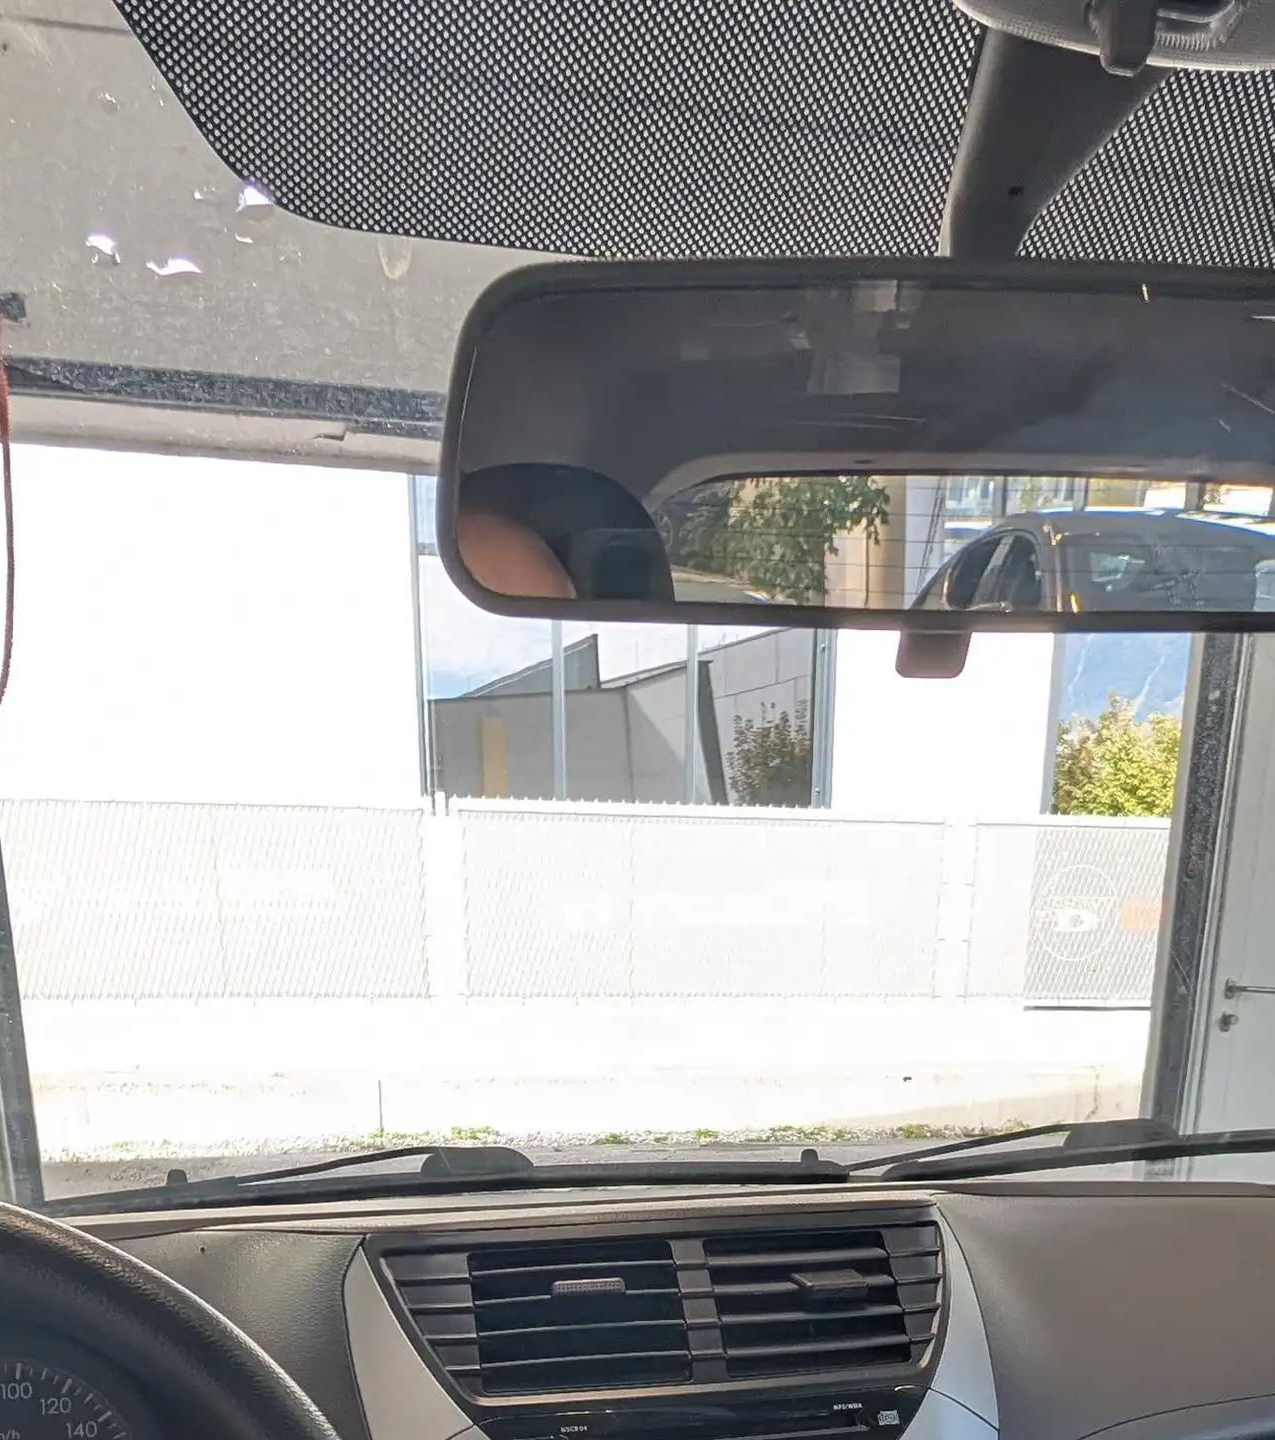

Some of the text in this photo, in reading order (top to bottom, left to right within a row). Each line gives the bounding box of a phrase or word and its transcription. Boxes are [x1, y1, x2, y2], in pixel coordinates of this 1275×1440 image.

[0, 1381, 32, 1400] 100
[40, 1398, 72, 1416] 120
[65, 1421, 97, 1439] 140
